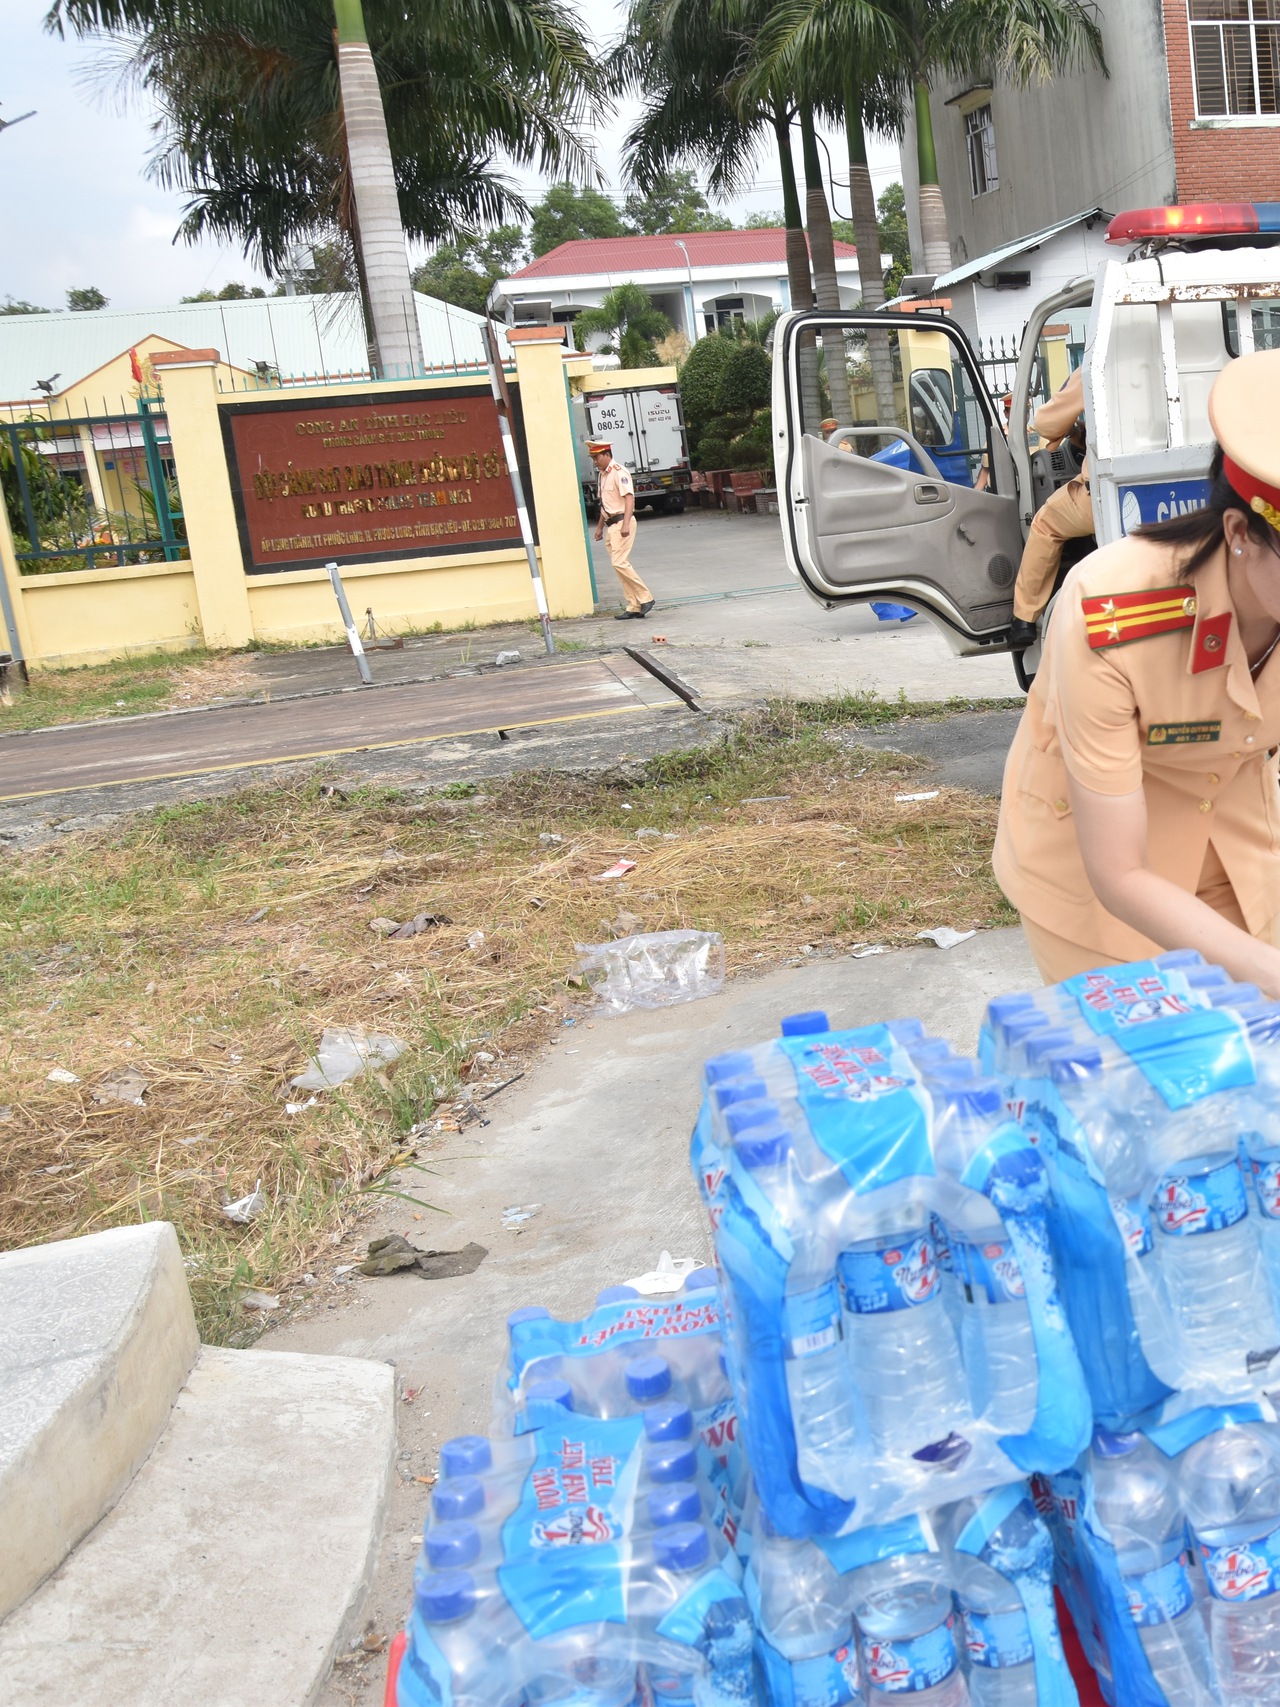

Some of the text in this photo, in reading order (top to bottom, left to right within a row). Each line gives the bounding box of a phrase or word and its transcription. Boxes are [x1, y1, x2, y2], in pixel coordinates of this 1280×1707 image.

[295, 409, 468, 435] CÔNG AN TỈNH BẠC LIÊU
[597, 420, 625, 431] 080.52
[601, 408, 616, 418] 94C
[323, 428, 446, 448] PHÒNG CẢNH SÁT GIAO THÔNG
[280, 461, 317, 497] CẢNH
[319, 463, 341, 494] SÁT
[375, 458, 418, 488] THÔNG
[463, 449, 481, 485] BỘ
[483, 444, 500, 478] SỐ
[302, 488, 472, 519] ROAD TRAFFIC POLICE TEAM NO.1
[1227, 1553, 1238, 1591] 1
